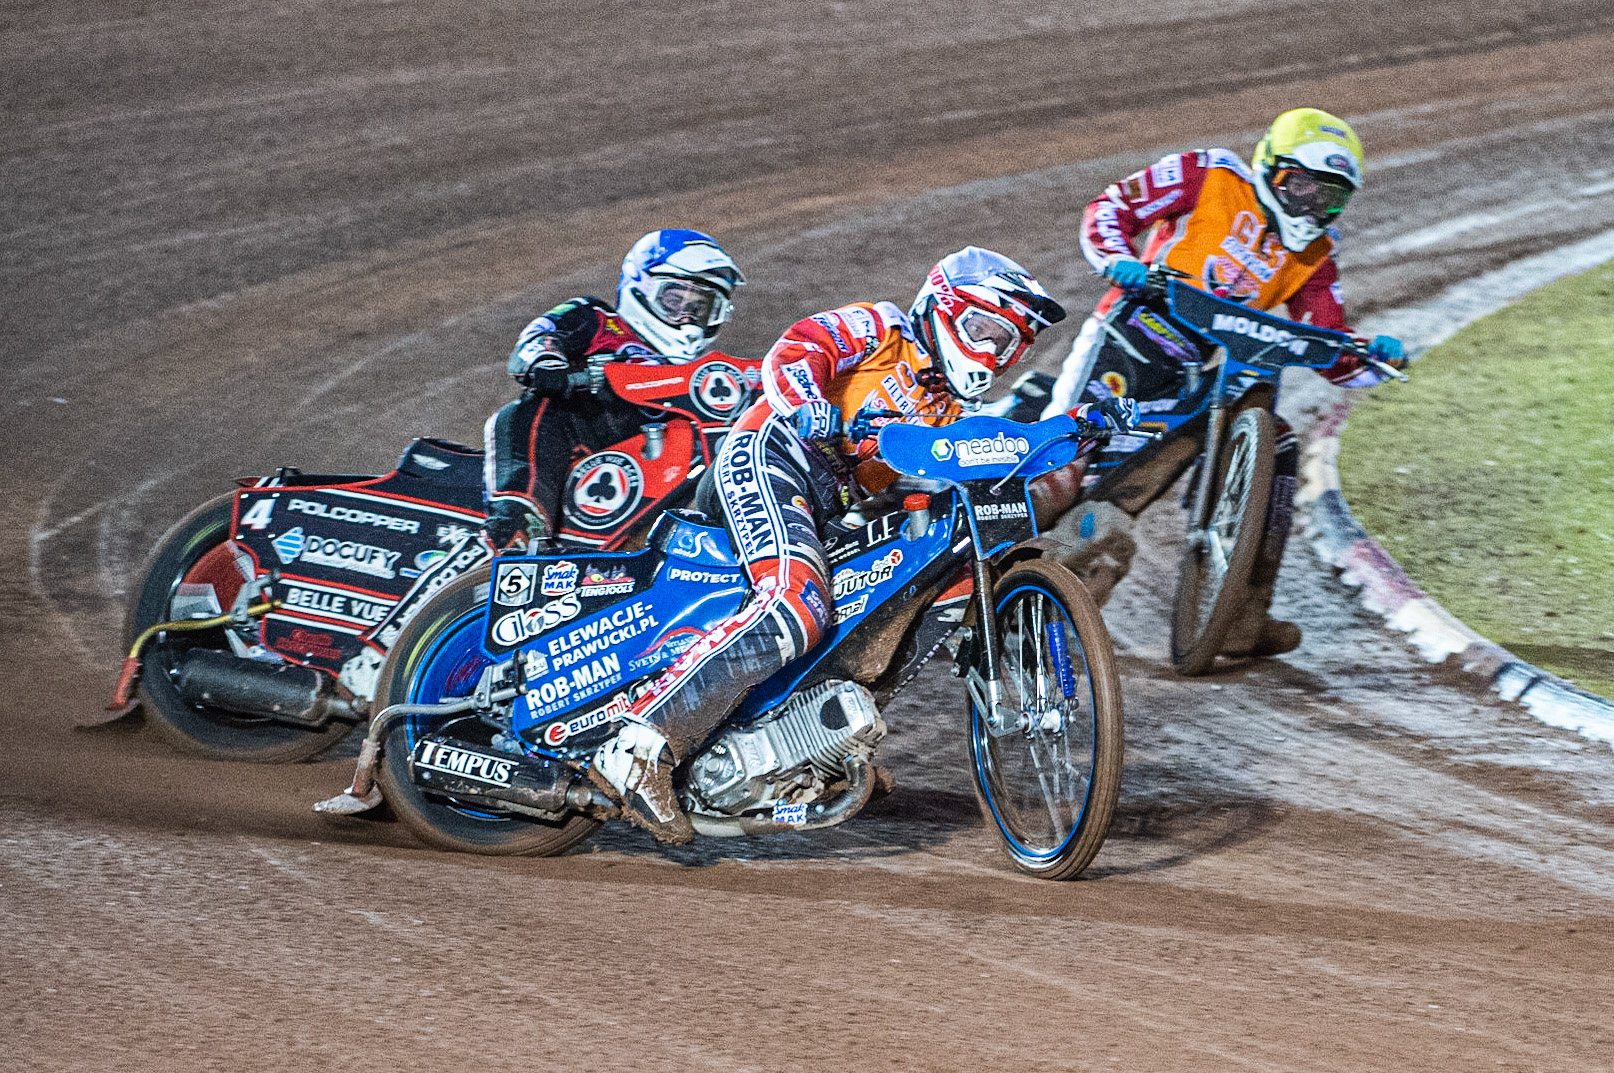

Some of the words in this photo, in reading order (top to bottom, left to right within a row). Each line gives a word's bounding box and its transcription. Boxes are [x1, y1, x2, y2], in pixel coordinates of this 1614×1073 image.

[957, 433, 1028, 456] neadoo
[731, 434, 773, 552] ROB-MAN
[974, 502, 1028, 516] ROB-MAN
[241, 499, 276, 530] 4
[287, 499, 420, 534] POLCOPPER
[727, 490, 755, 556] SKRZYPEK
[304, 535, 402, 573] DOCUFY
[506, 575, 521, 593] 5
[544, 580, 574, 590] MAK
[545, 566, 576, 580] Smak
[670, 569, 741, 583] PROTECT
[287, 588, 346, 612] BELLE
[351, 599, 390, 622] VUE
[549, 602, 653, 656] ELEWACJE-
[552, 615, 659, 671] PRAWUCKI.PL
[525, 652, 620, 711] ROB-MAN
[530, 697, 570, 719] ROBERT
[573, 672, 622, 702] SKRZYPEK
[569, 696, 630, 733] euromit
[421, 741, 512, 782] TEMPUS
